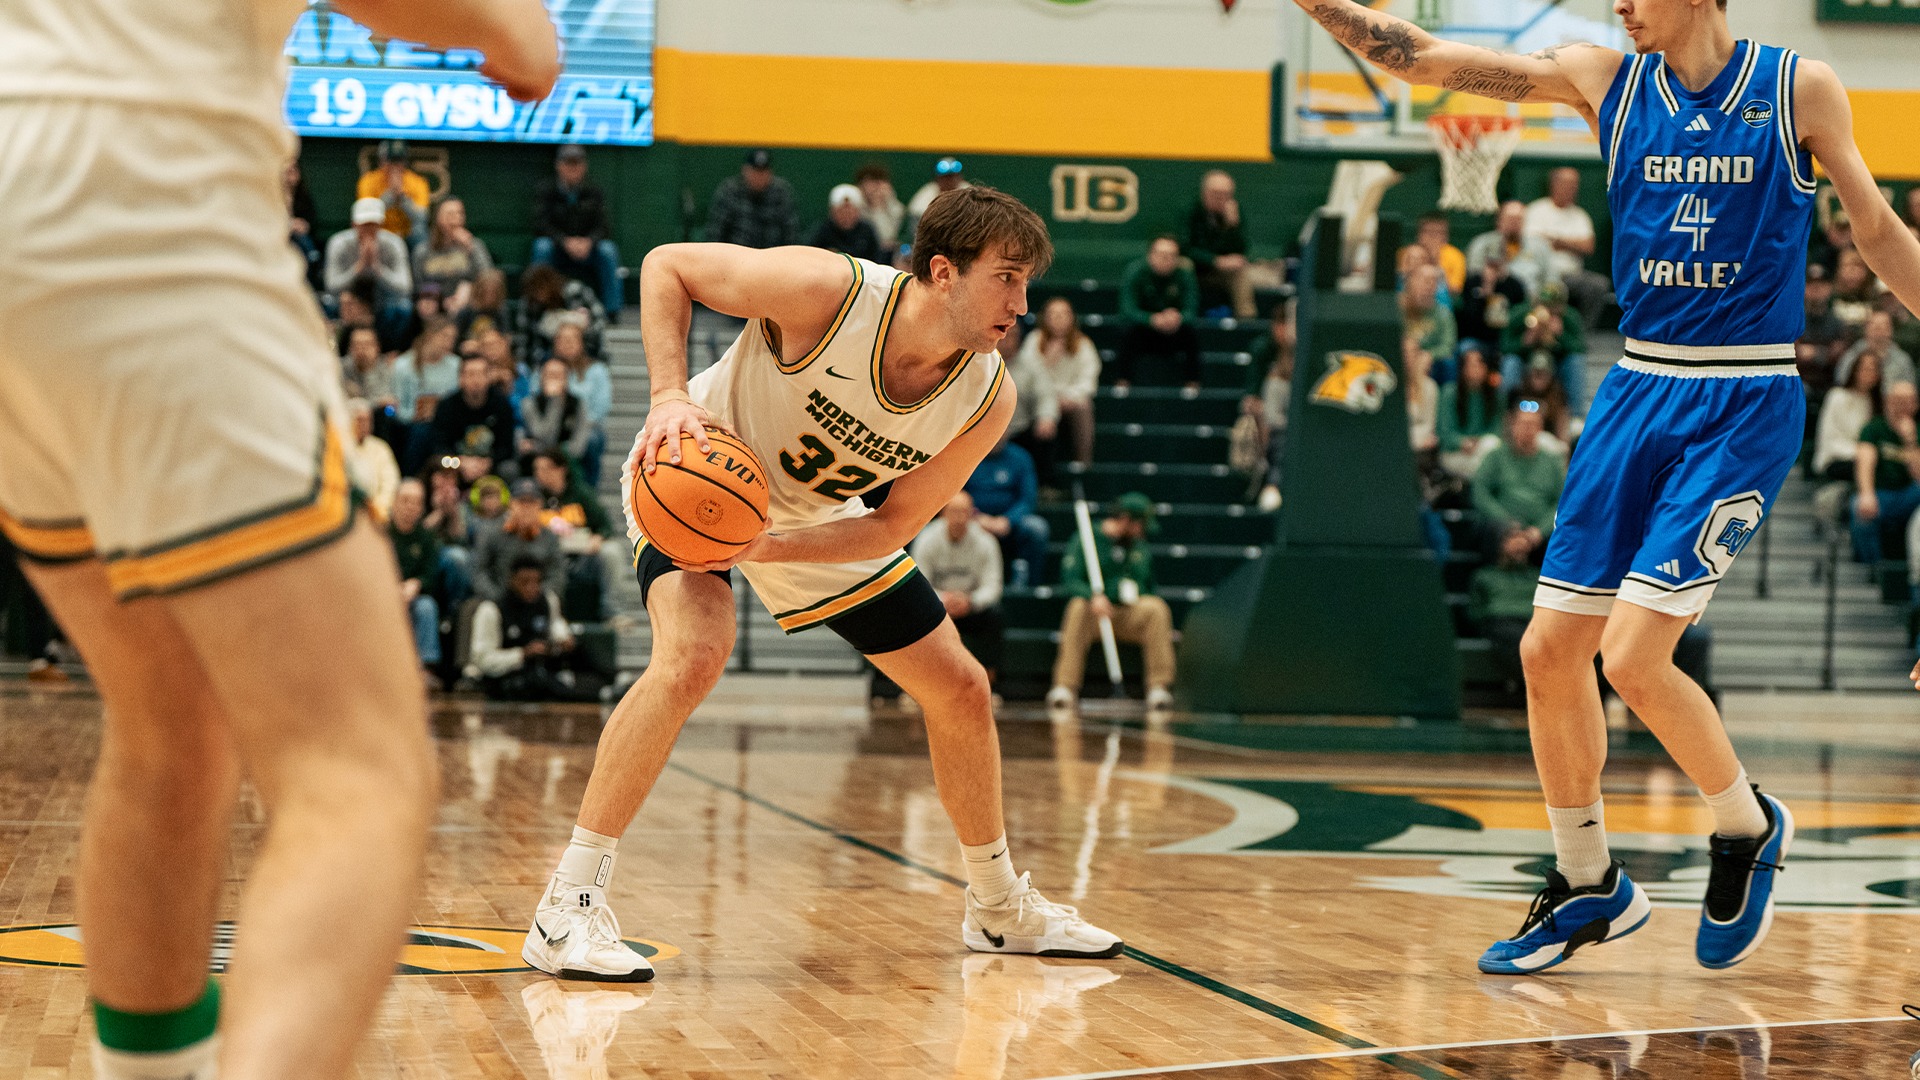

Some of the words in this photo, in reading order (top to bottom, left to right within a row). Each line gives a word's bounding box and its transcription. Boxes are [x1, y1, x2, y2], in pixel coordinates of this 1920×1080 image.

[307, 77, 367, 127] 19
[381, 82, 515, 130] GVSU
[1051, 165, 1139, 223] 16
[1643, 155, 1755, 184] GRAND
[1669, 193, 1717, 252] 4
[804, 402, 917, 472] MICHIGAN
[807, 387, 933, 465] NORTHERN
[705, 450, 756, 485] EVO
[778, 431, 881, 506] 32
